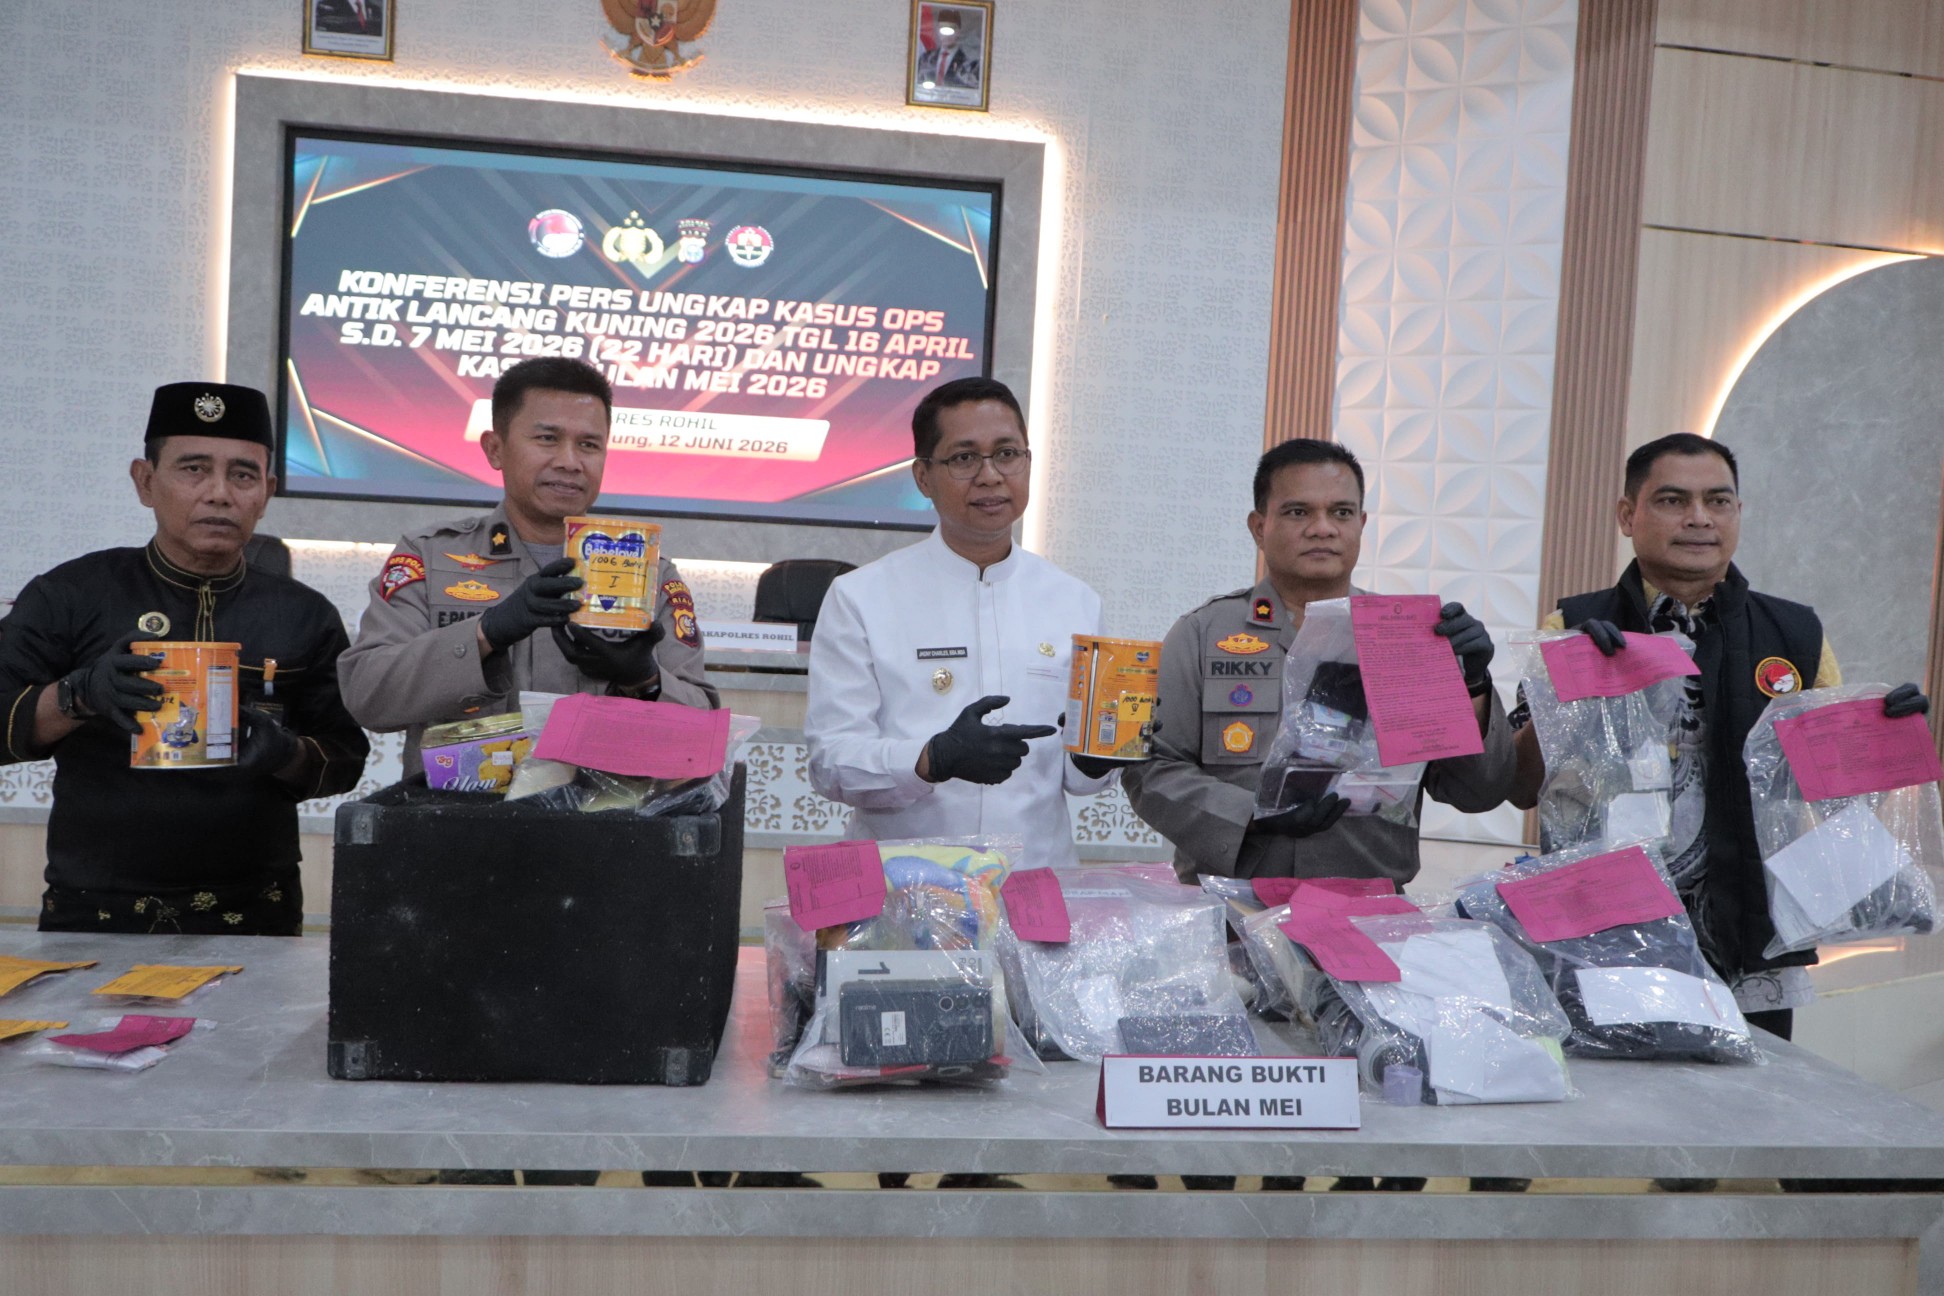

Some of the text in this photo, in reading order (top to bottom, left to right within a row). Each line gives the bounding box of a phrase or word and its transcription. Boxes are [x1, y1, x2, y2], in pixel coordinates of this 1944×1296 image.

[338, 270, 944, 332] KONFERENSI PERS UNGKAP KASUS OPS
[301, 293, 974, 360] ANTIK LANCANG KUNING 2026 TGL 16 APRIL
[340, 322, 941, 381] S.D. 7 MEI 2026 (22 HARI) DAN UNGKAP
[596, 361, 678, 390] ULAN
[683, 370, 743, 393] MEI
[747, 373, 828, 398] 2026
[615, 412, 717, 430] RES ROHIL
[612, 434, 789, 454] ung, 12 JUNI 2026
[701, 631, 795, 641] AKAPOLRES ROHIL
[1211, 660, 1273, 676] RIKKY
[1138, 1065, 1326, 1083] BARANG BUKTI
[1167, 1098, 1302, 1116] BULAN MEI
